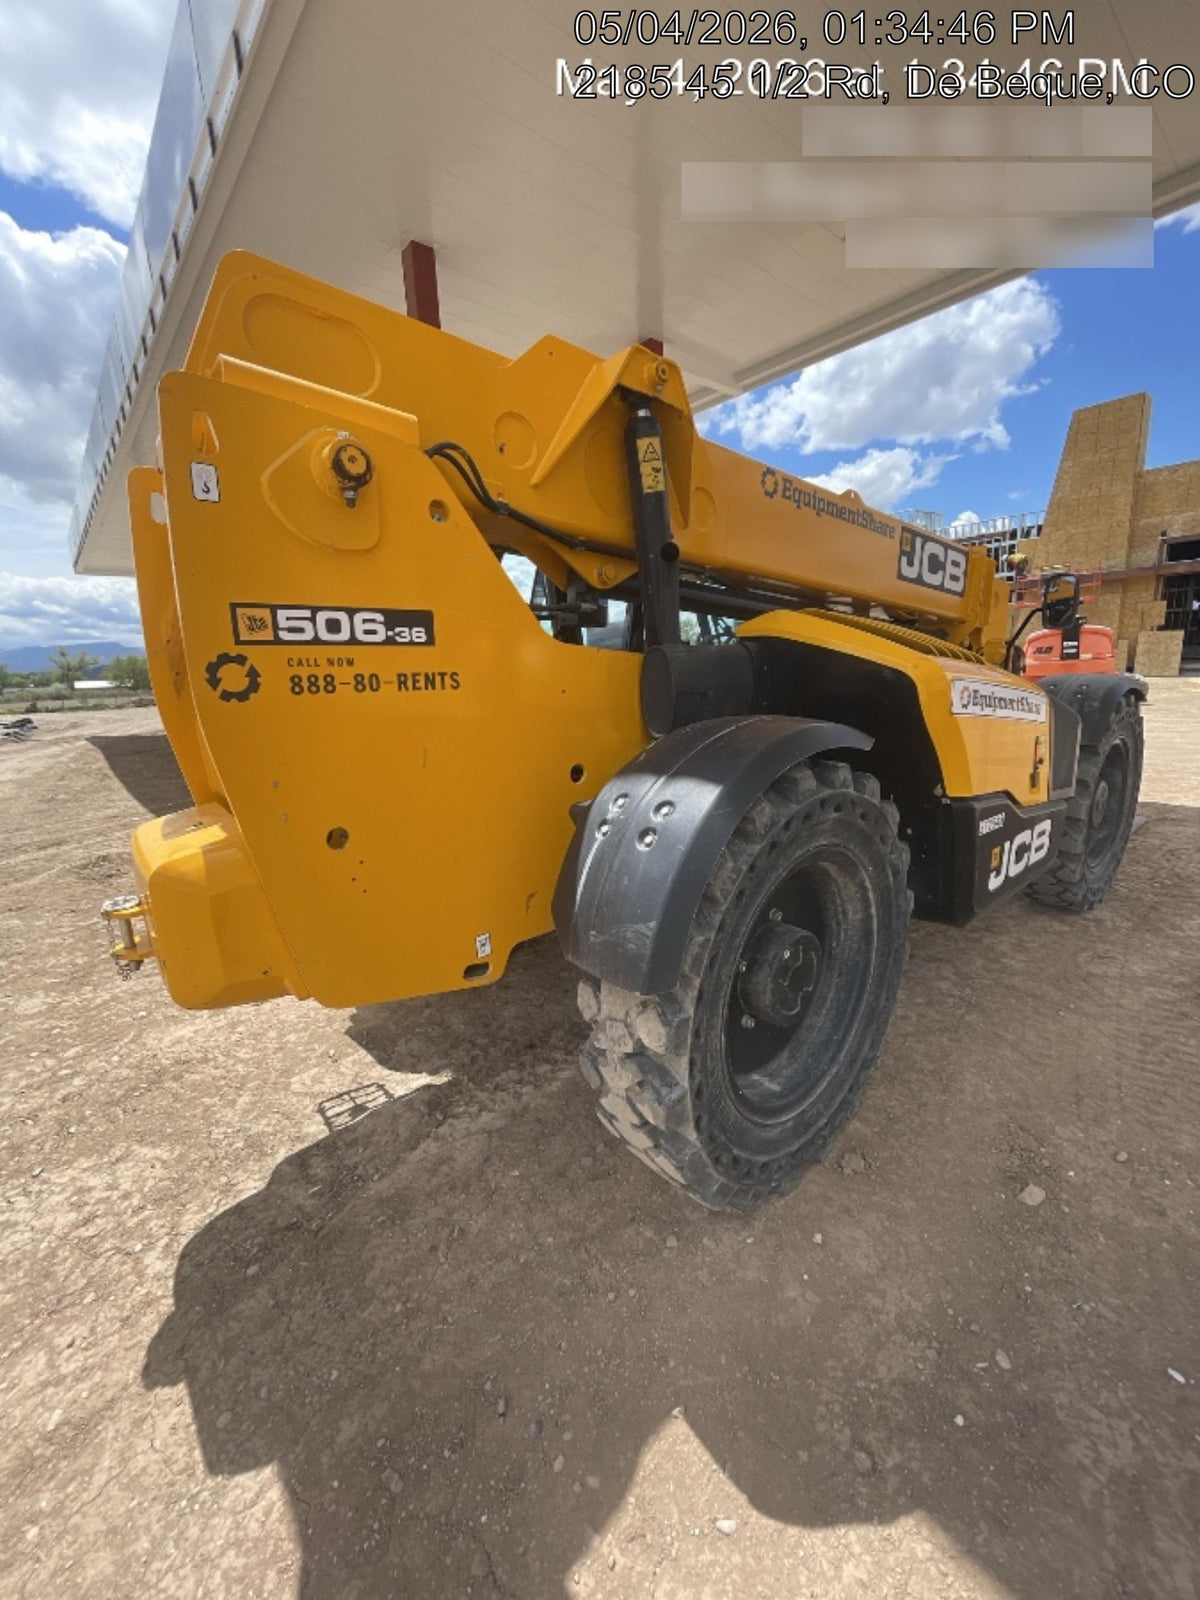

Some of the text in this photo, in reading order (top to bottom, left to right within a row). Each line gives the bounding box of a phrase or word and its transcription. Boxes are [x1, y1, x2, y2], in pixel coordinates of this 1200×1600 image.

[780, 476, 896, 540] EquipmentShare
[900, 536, 967, 593] JCB
[287, 657, 355, 668] CALL NOW
[289, 671, 461, 696] 888-80-RENTS
[988, 818, 1052, 893] JCB
